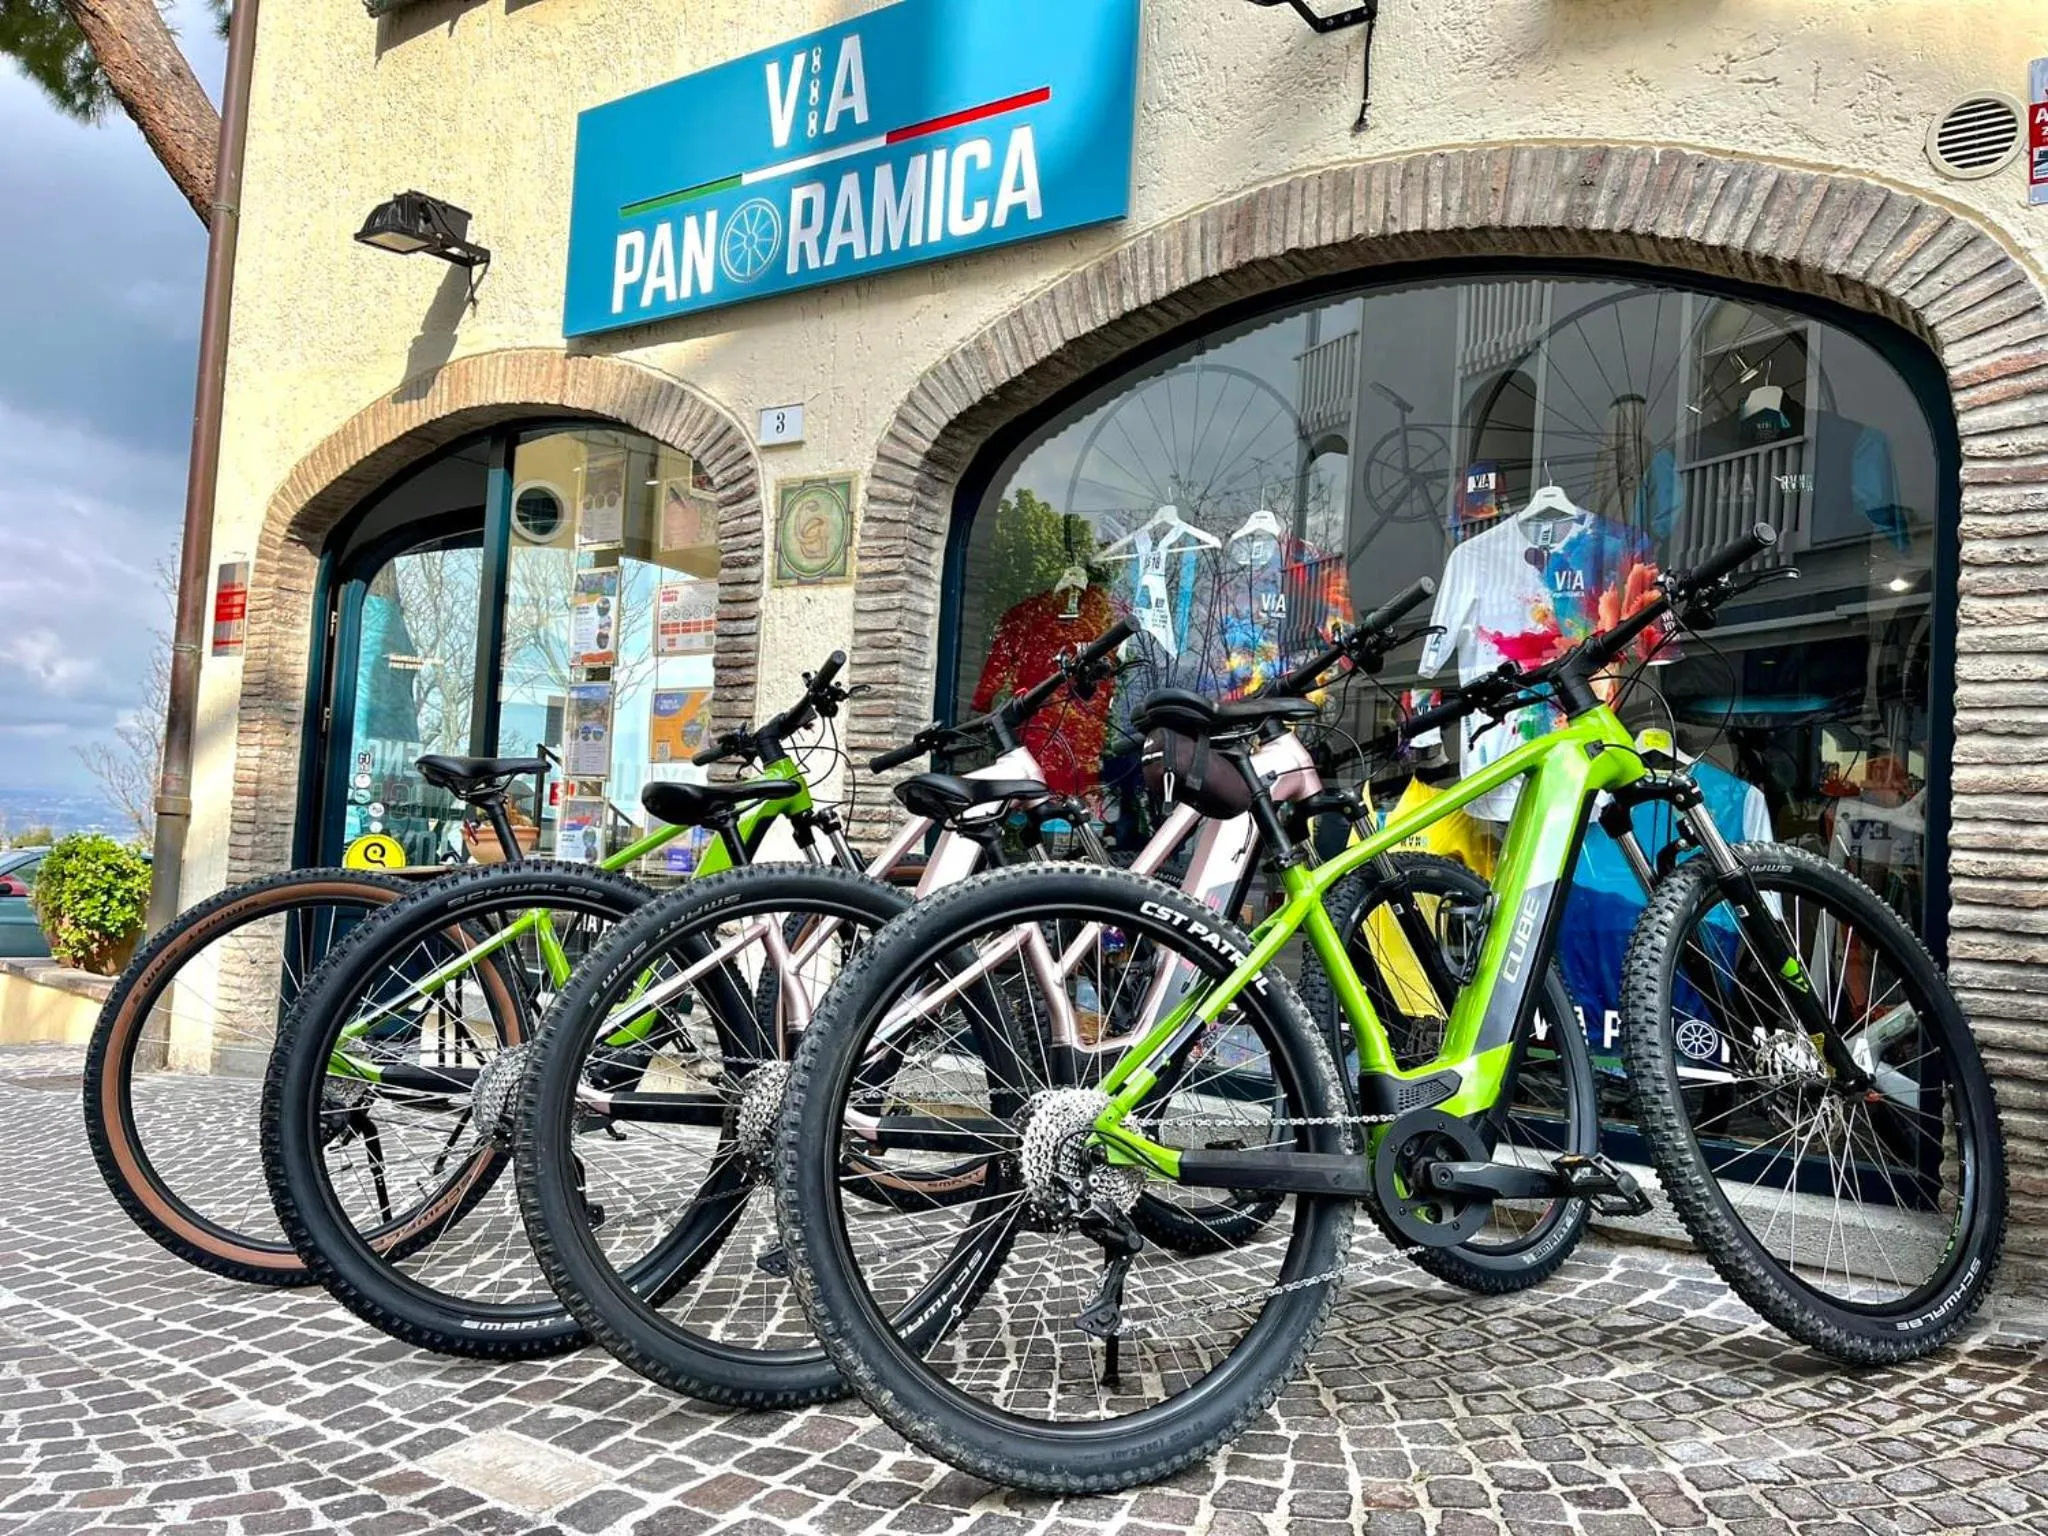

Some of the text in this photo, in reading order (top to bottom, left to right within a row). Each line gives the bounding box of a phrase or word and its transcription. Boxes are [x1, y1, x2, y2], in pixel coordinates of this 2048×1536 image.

[765, 34, 870, 149] VIA
[775, 411, 786, 434] 3
[1554, 570, 1584, 591] VIA
[1261, 592, 1286, 612] VIA
[447, 883, 604, 909] SCHWALBE
[1139, 900, 1269, 996] CST PATRL
[1503, 895, 1540, 984] CUBE
[1895, 1256, 1982, 1332] SCHWALBE
[460, 1316, 557, 1331] SMART
